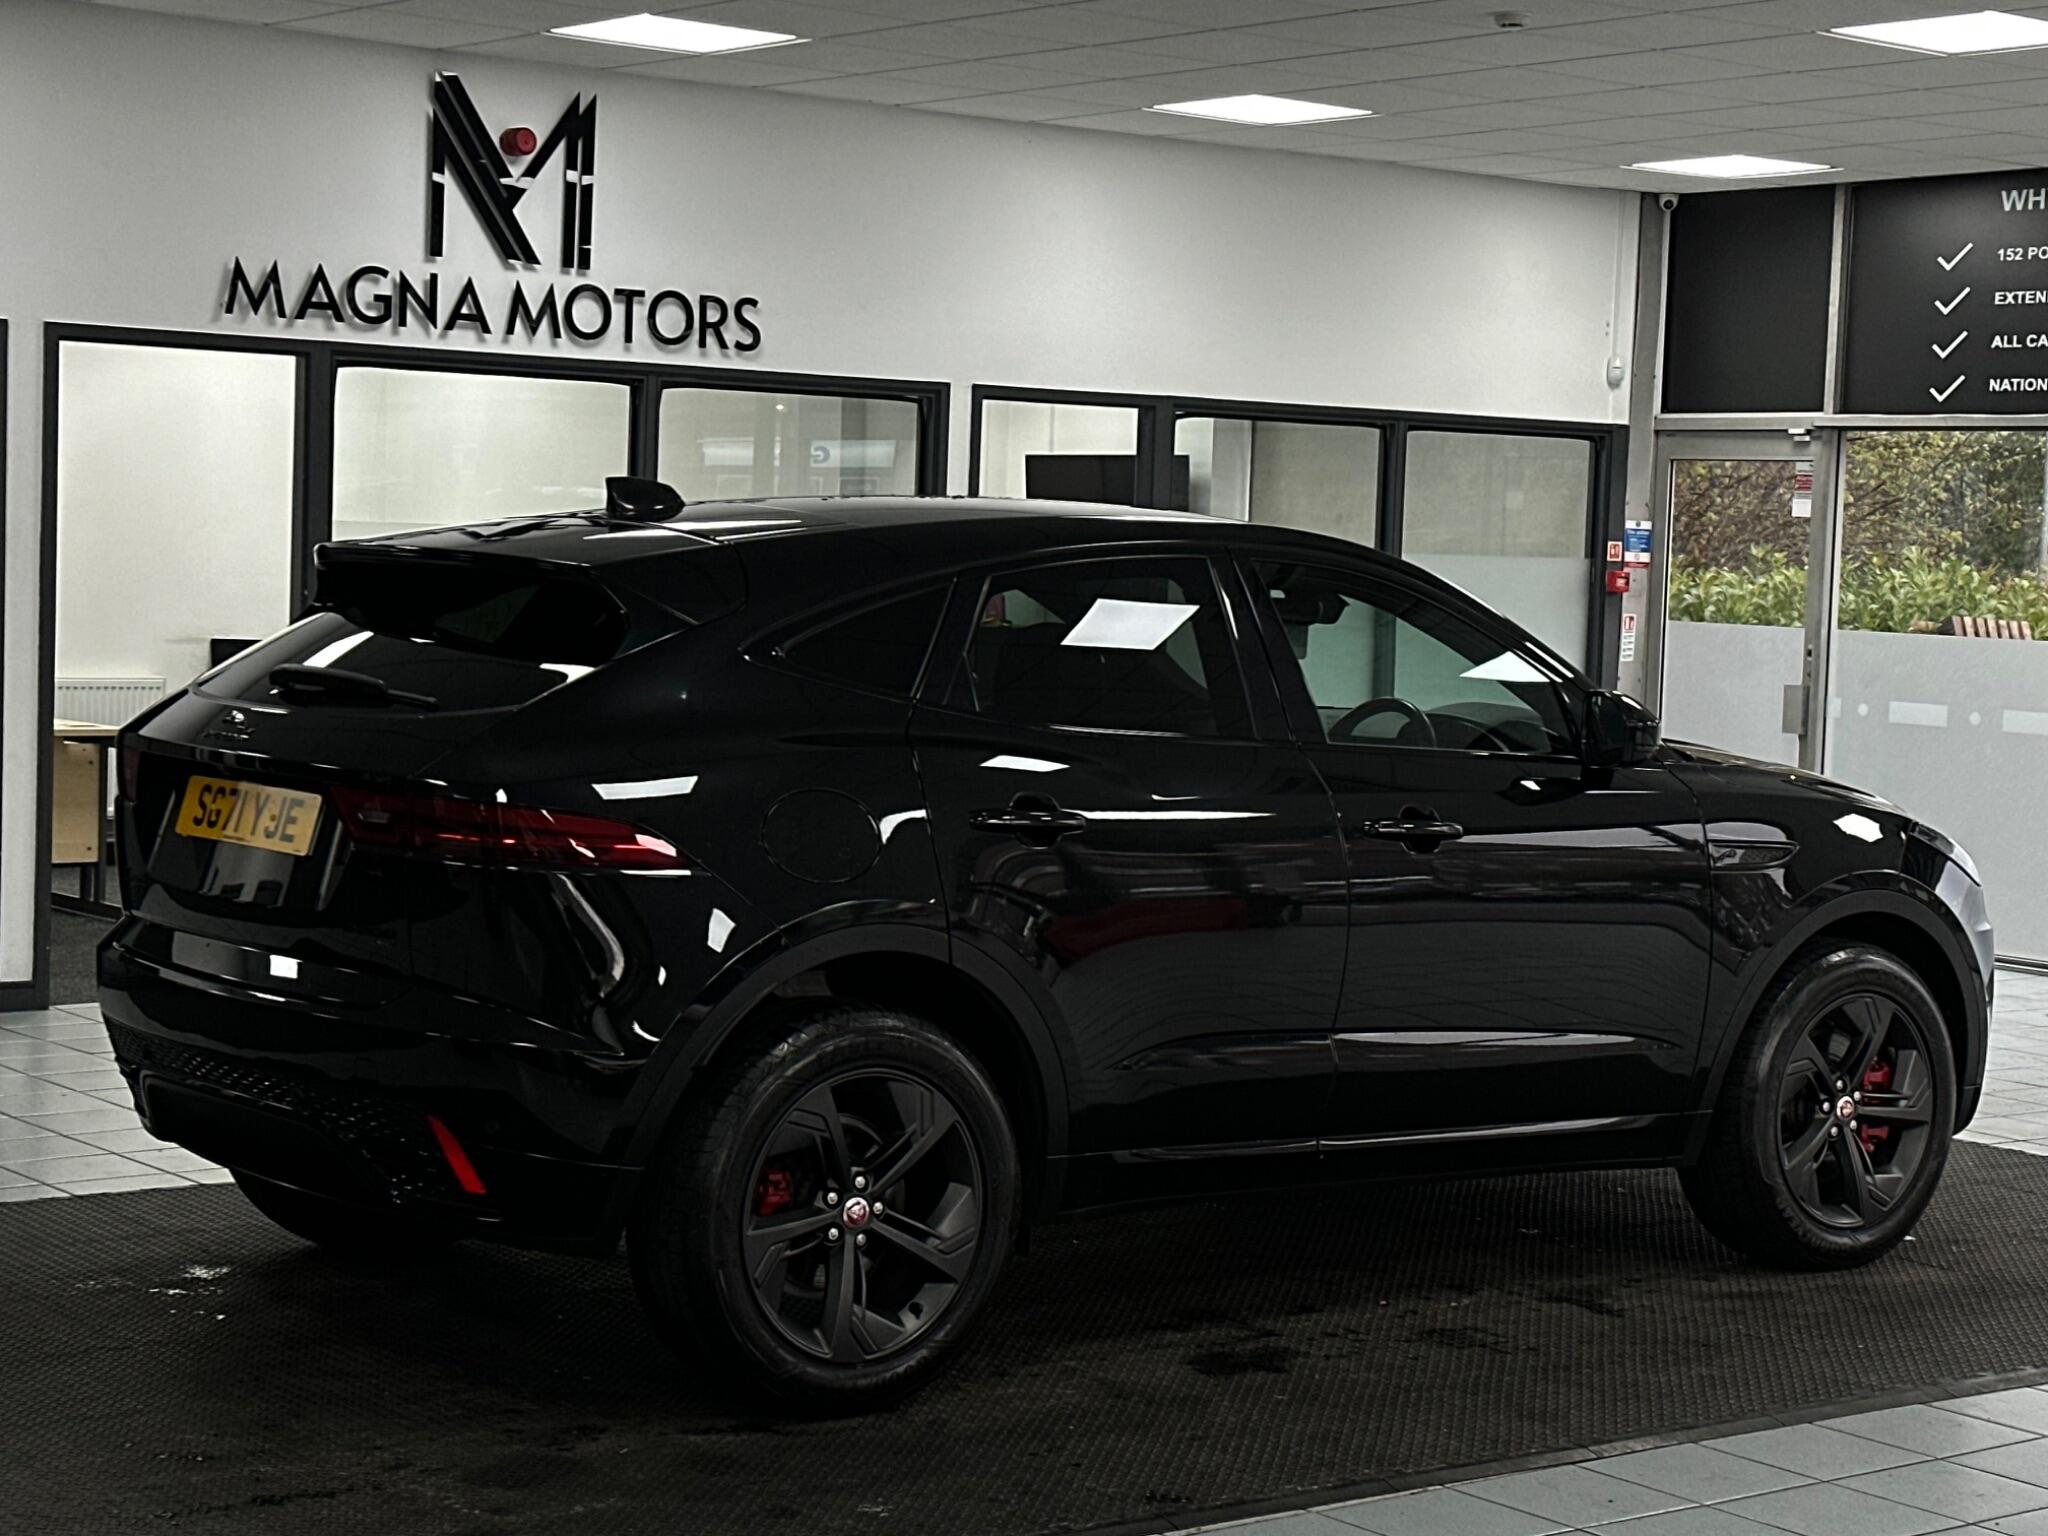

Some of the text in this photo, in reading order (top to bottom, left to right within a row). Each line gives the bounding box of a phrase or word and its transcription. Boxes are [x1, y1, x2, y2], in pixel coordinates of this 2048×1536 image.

[2000, 187, 2048, 211] WH
[1997, 247, 2024, 261] 152
[224, 256, 762, 352] MAGNA MOTORS
[1994, 290, 2048, 305] EXTEN
[1991, 334, 2048, 349] ALL CA
[1989, 378, 2048, 392] NATION
